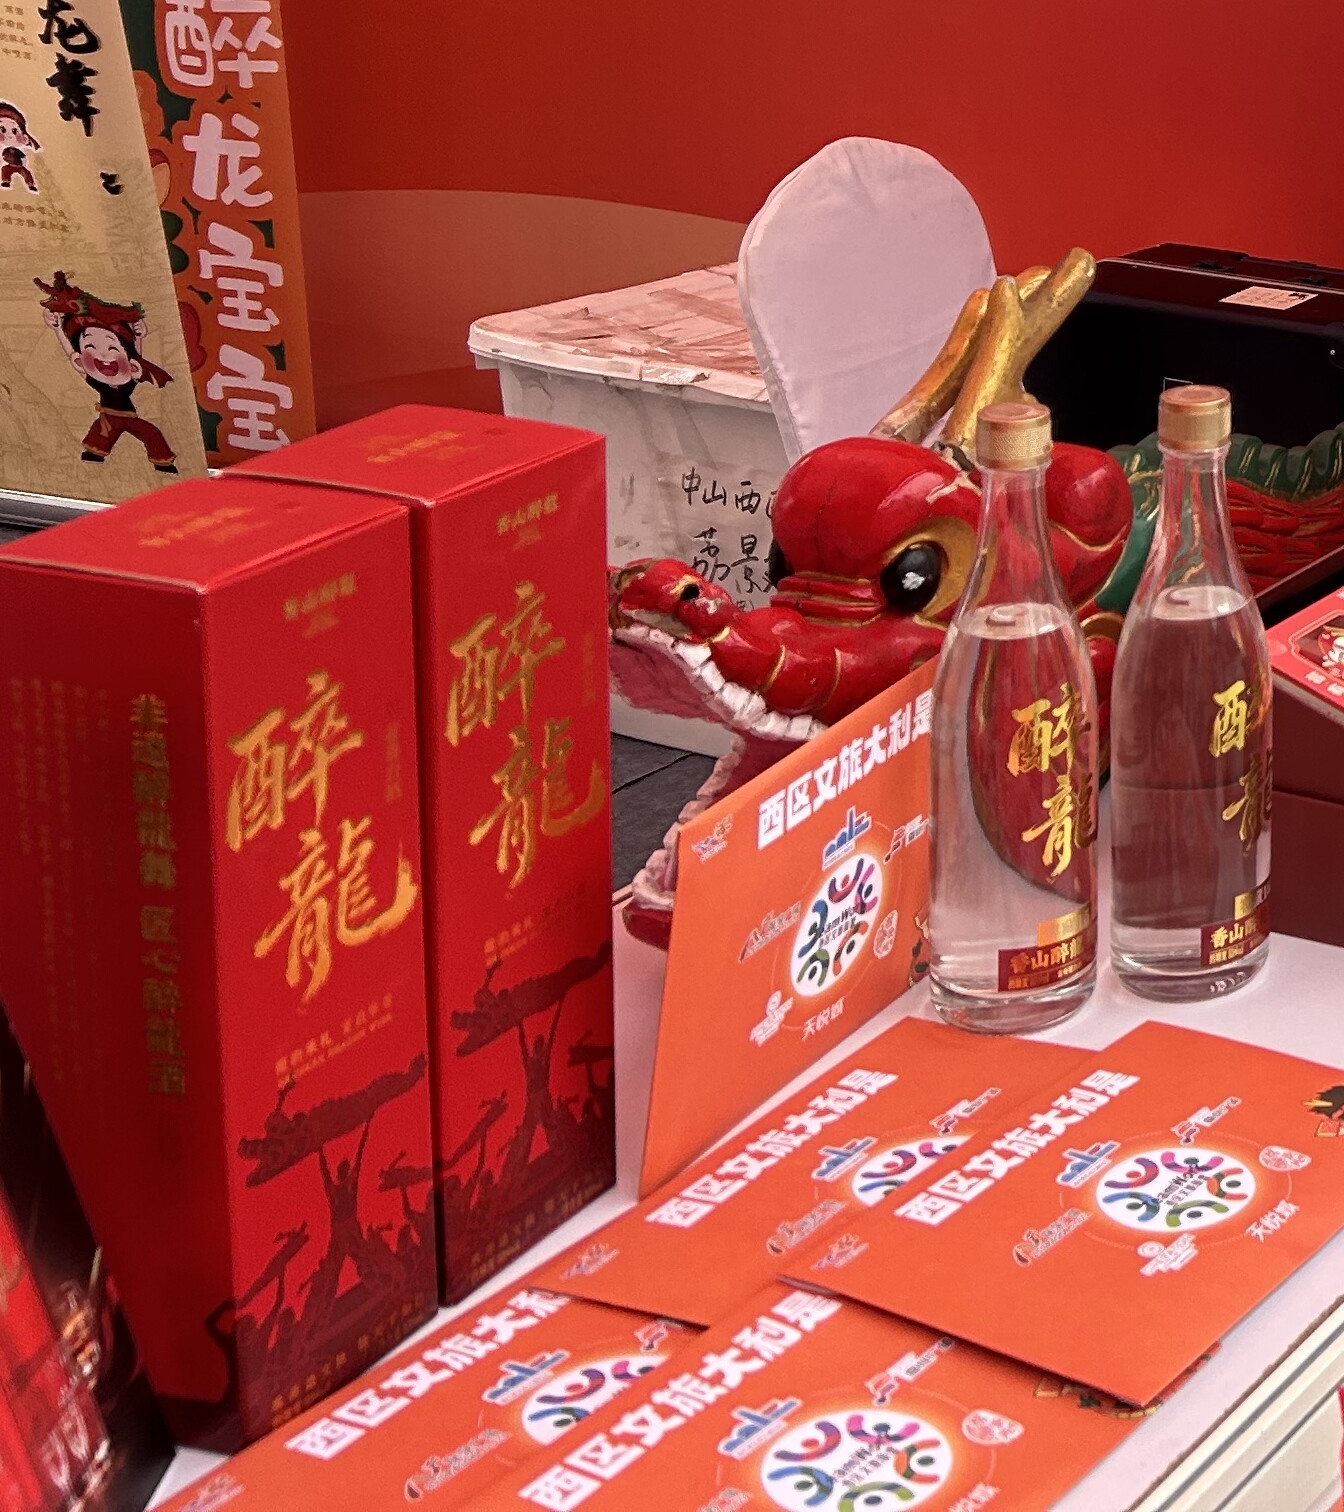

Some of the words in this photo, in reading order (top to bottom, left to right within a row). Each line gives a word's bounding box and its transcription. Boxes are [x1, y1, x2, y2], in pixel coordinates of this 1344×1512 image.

[444, 579, 603, 888] 醉龍
[757, 688, 933, 852] 西区文旅大利是
[222, 669, 419, 1004] 醉龍
[645, 1068, 899, 1229] 西区文旅大利是
[894, 1069, 1141, 1227] 西区文旅大利是
